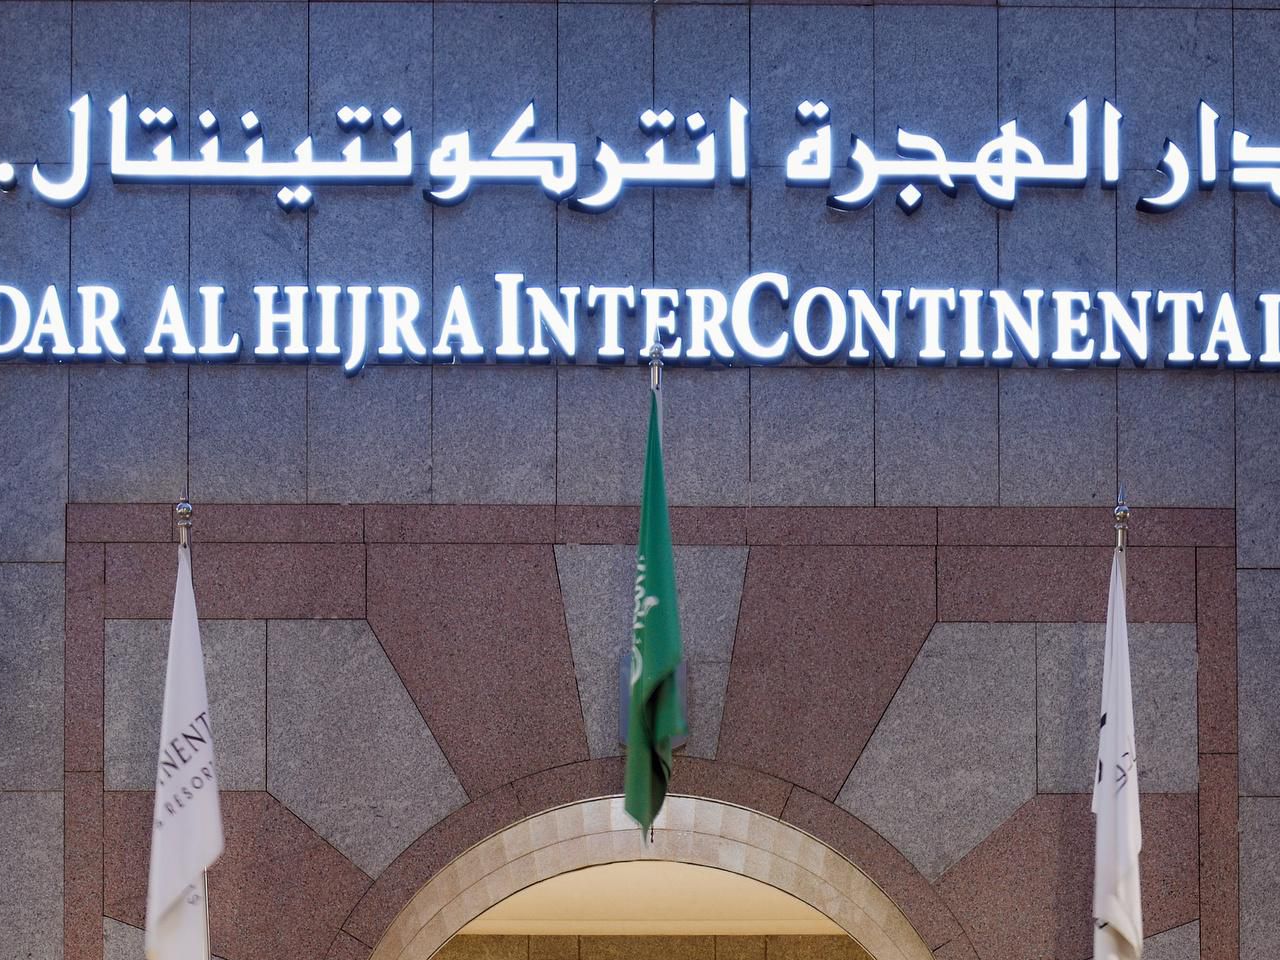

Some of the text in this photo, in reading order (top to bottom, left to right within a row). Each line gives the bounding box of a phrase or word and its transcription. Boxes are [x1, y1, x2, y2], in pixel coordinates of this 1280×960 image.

[784, 97, 1123, 208] الهجرة
[143, 284, 241, 355] AL
[253, 284, 484, 372] HIJRA
